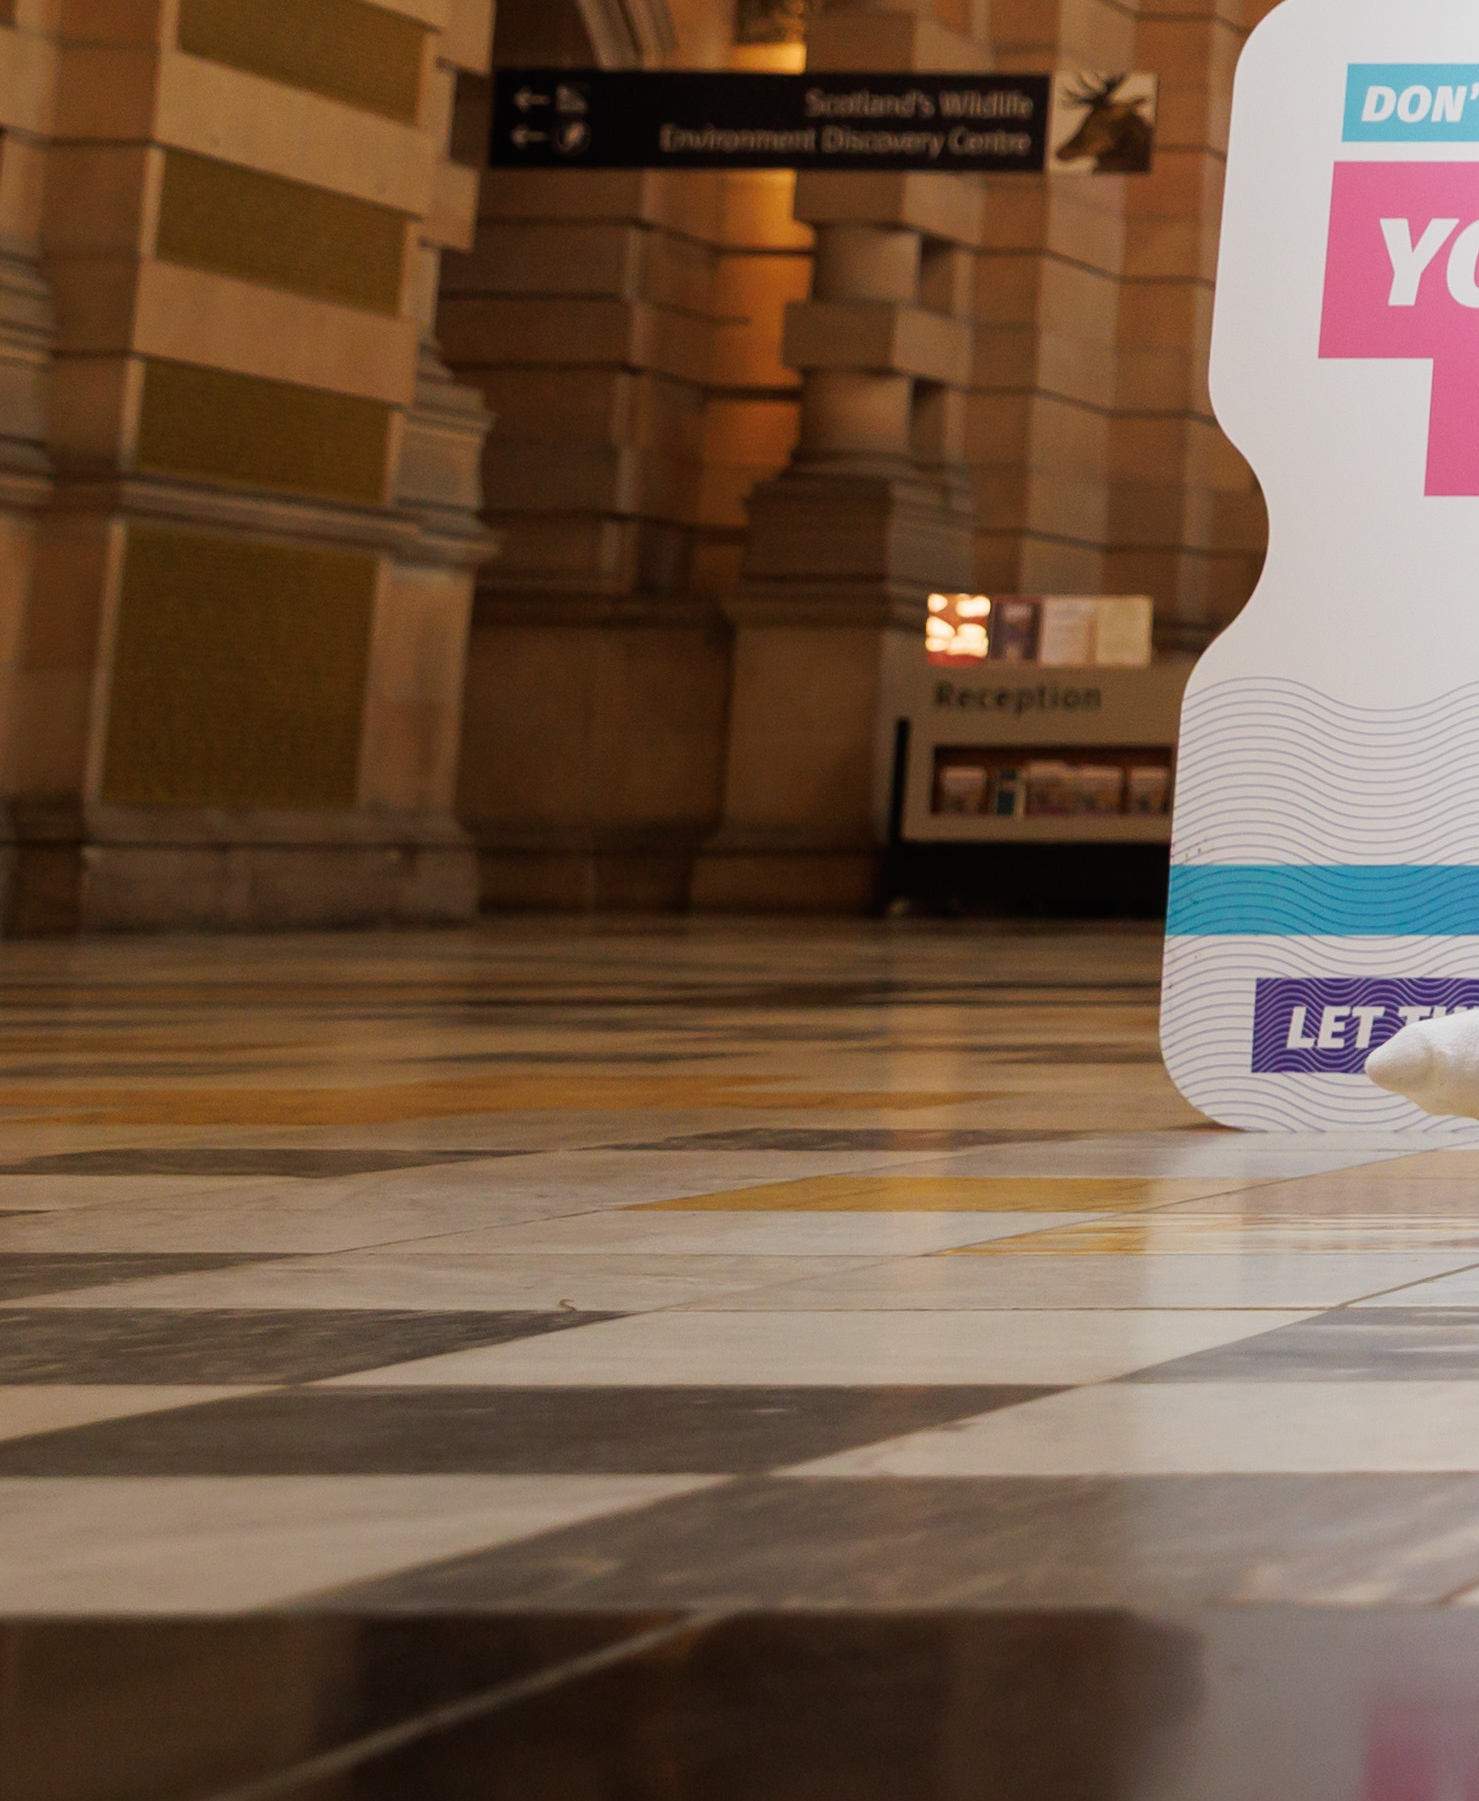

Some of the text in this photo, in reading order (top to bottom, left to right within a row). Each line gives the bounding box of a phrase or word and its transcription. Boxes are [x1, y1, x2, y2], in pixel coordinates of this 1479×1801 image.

[804, 87, 1034, 119] Scotland's Wildlife
[658, 121, 1033, 159] Environment Discovery Centre
[931, 680, 1102, 719] Reception
[1286, 1004, 1387, 1050] LET
